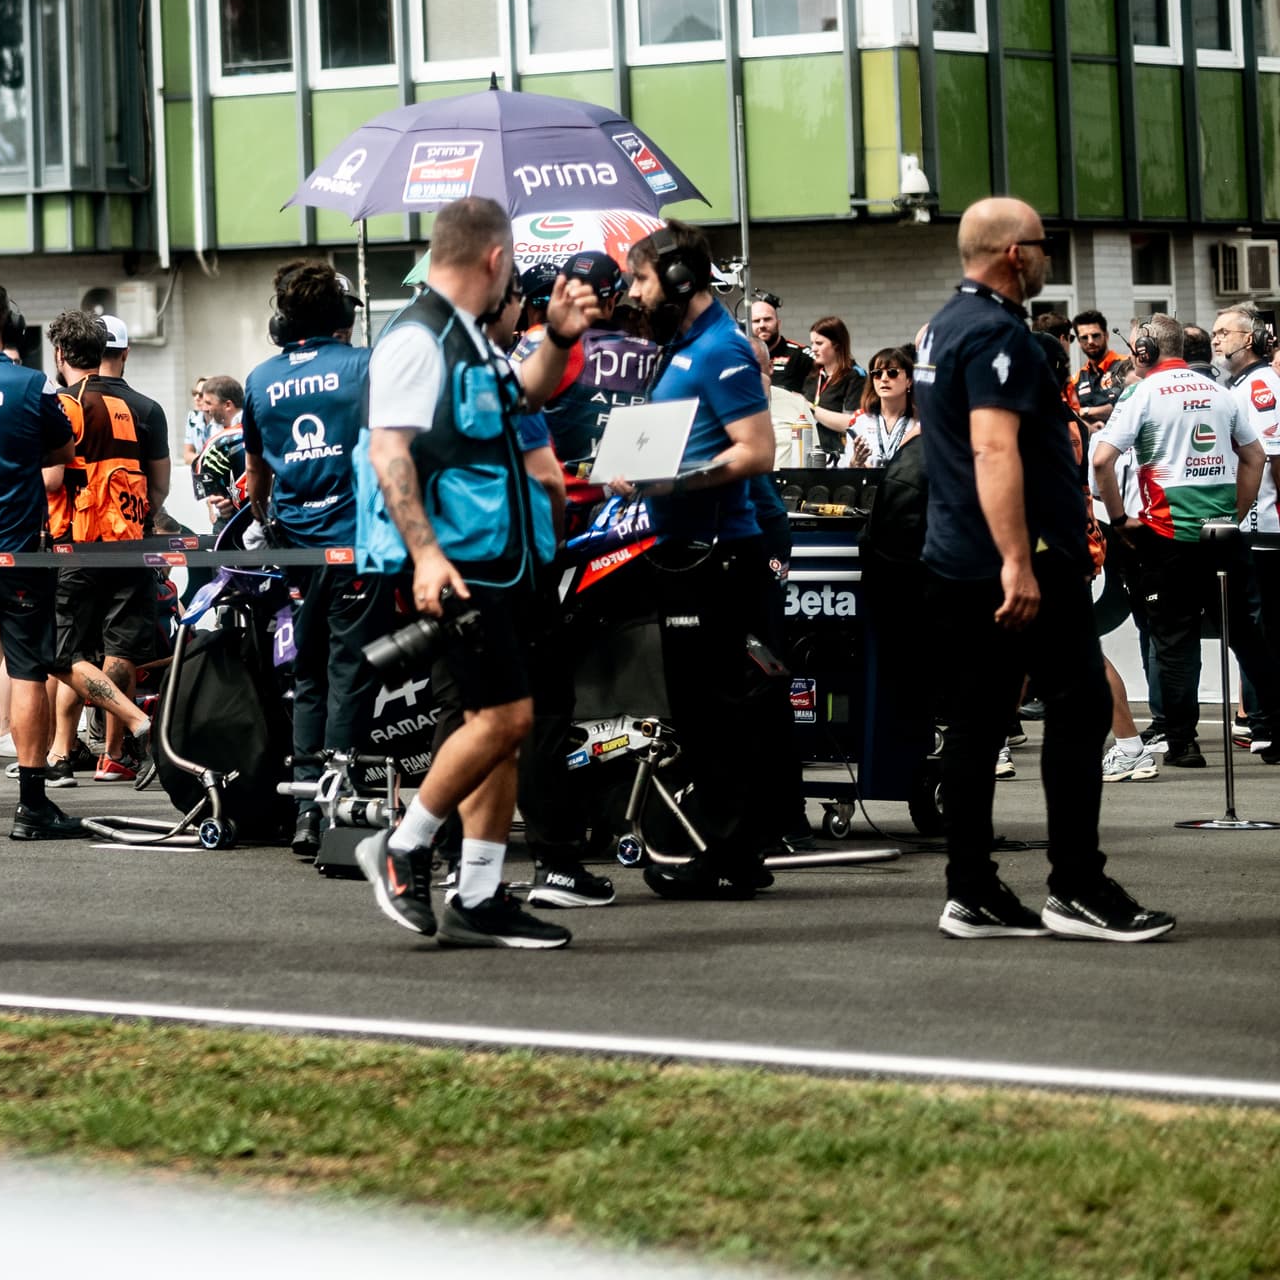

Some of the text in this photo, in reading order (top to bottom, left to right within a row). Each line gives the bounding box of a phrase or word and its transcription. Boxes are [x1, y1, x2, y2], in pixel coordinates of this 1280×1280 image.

[426, 145, 466, 159] prima
[513, 162, 618, 195] prima
[422, 182, 467, 198] YAMAHA
[513, 240, 584, 253] Castrol
[265, 372, 340, 407] prima
[1159, 382, 1219, 396] HONDA
[1183, 398, 1212, 411] HRC
[284, 444, 344, 465] PRAMAC
[1185, 455, 1225, 467] Castrol
[1185, 467, 1226, 478] POWER1
[118, 490, 144, 526] 230
[590, 548, 633, 572] MOTUL
[784, 584, 857, 617] Beta
[546, 872, 576, 889] HOKA
